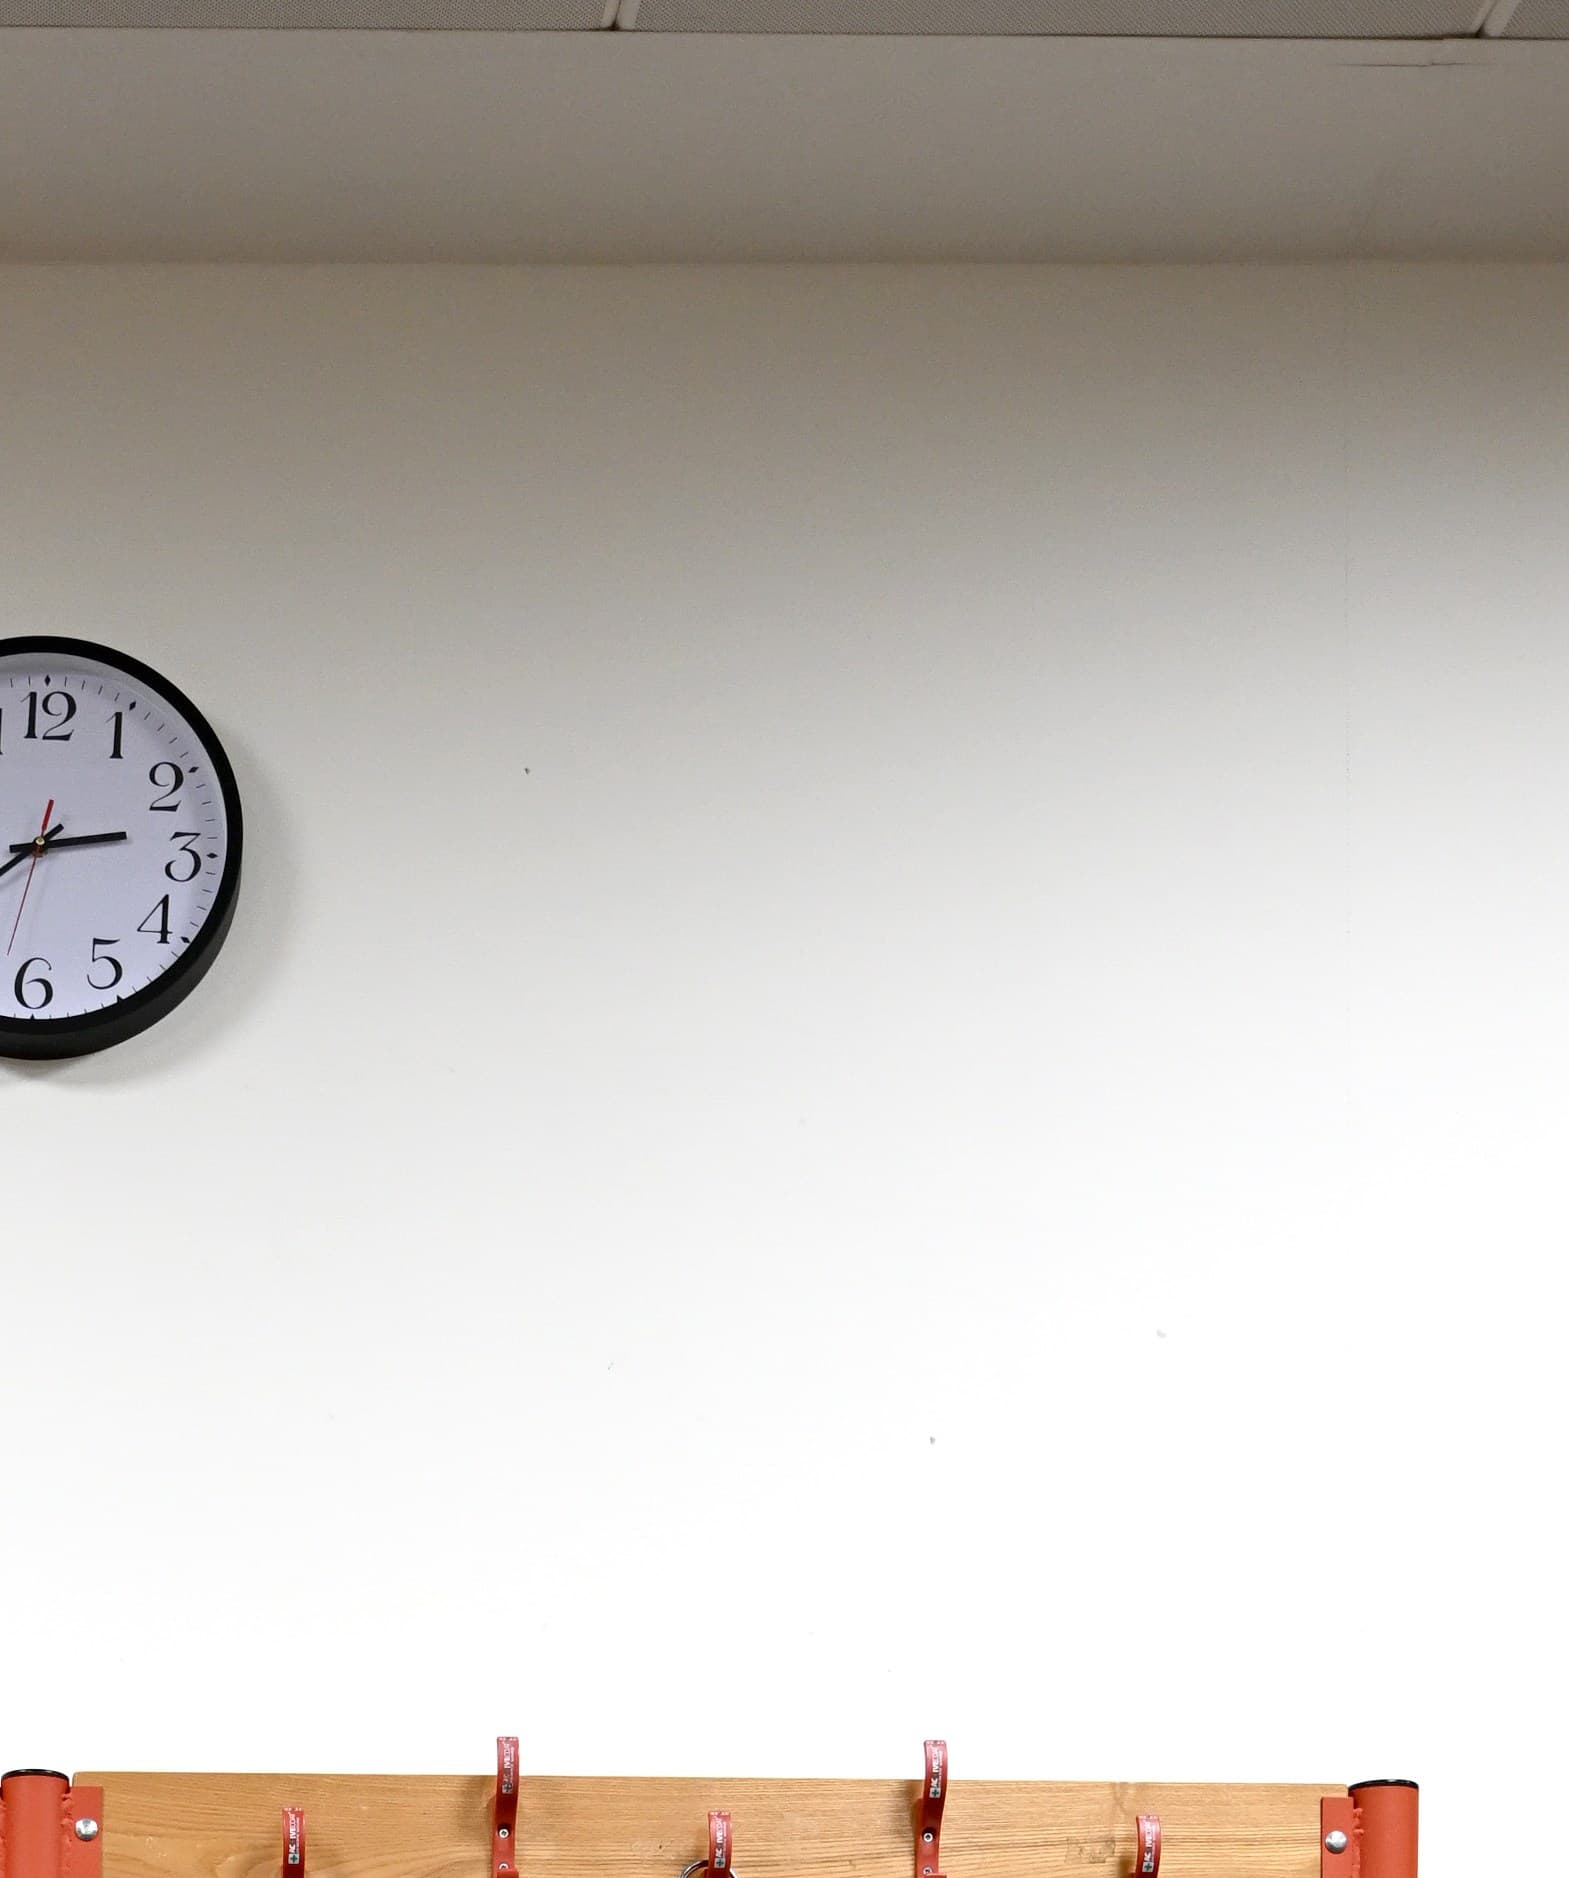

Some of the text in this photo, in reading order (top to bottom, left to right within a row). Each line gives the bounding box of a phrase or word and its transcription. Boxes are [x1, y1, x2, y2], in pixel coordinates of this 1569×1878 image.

[21, 691, 77, 740] 12
[107, 712, 124, 759] 1
[148, 762, 184, 811] 2
[164, 832, 202, 882] 3
[136, 894, 173, 944] 4
[14, 957, 53, 1009] 6
[87, 937, 123, 989] 5
